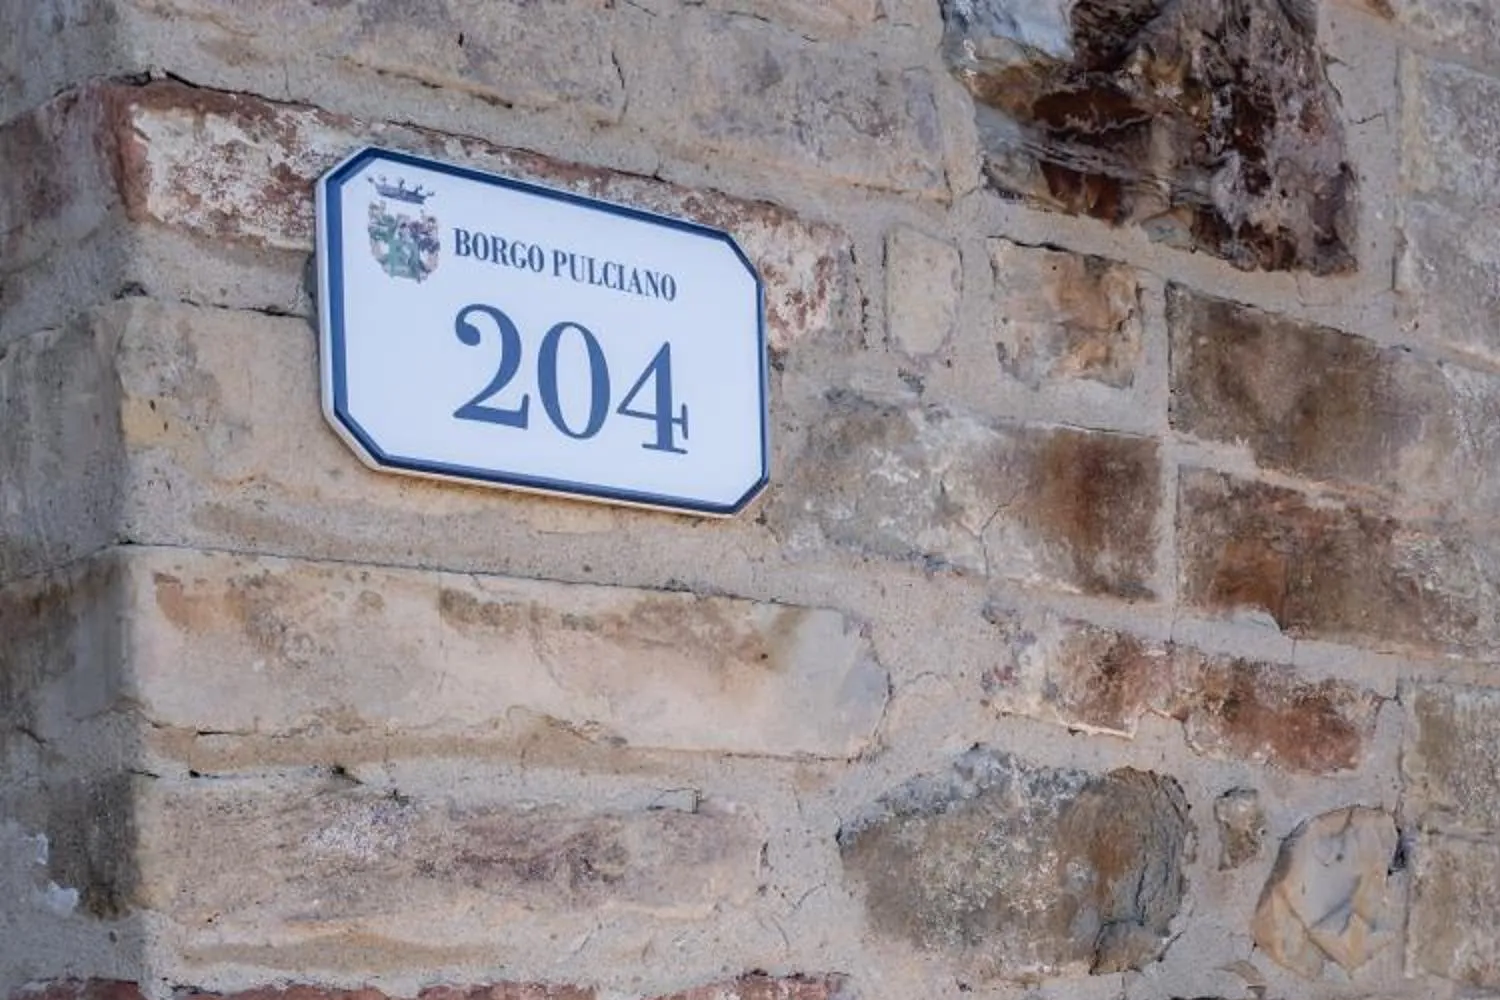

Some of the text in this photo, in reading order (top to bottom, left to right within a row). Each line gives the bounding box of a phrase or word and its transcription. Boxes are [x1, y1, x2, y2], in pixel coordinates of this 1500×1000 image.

[452, 227, 677, 302] BORGO PULCIANO
[452, 303, 689, 455] 204
